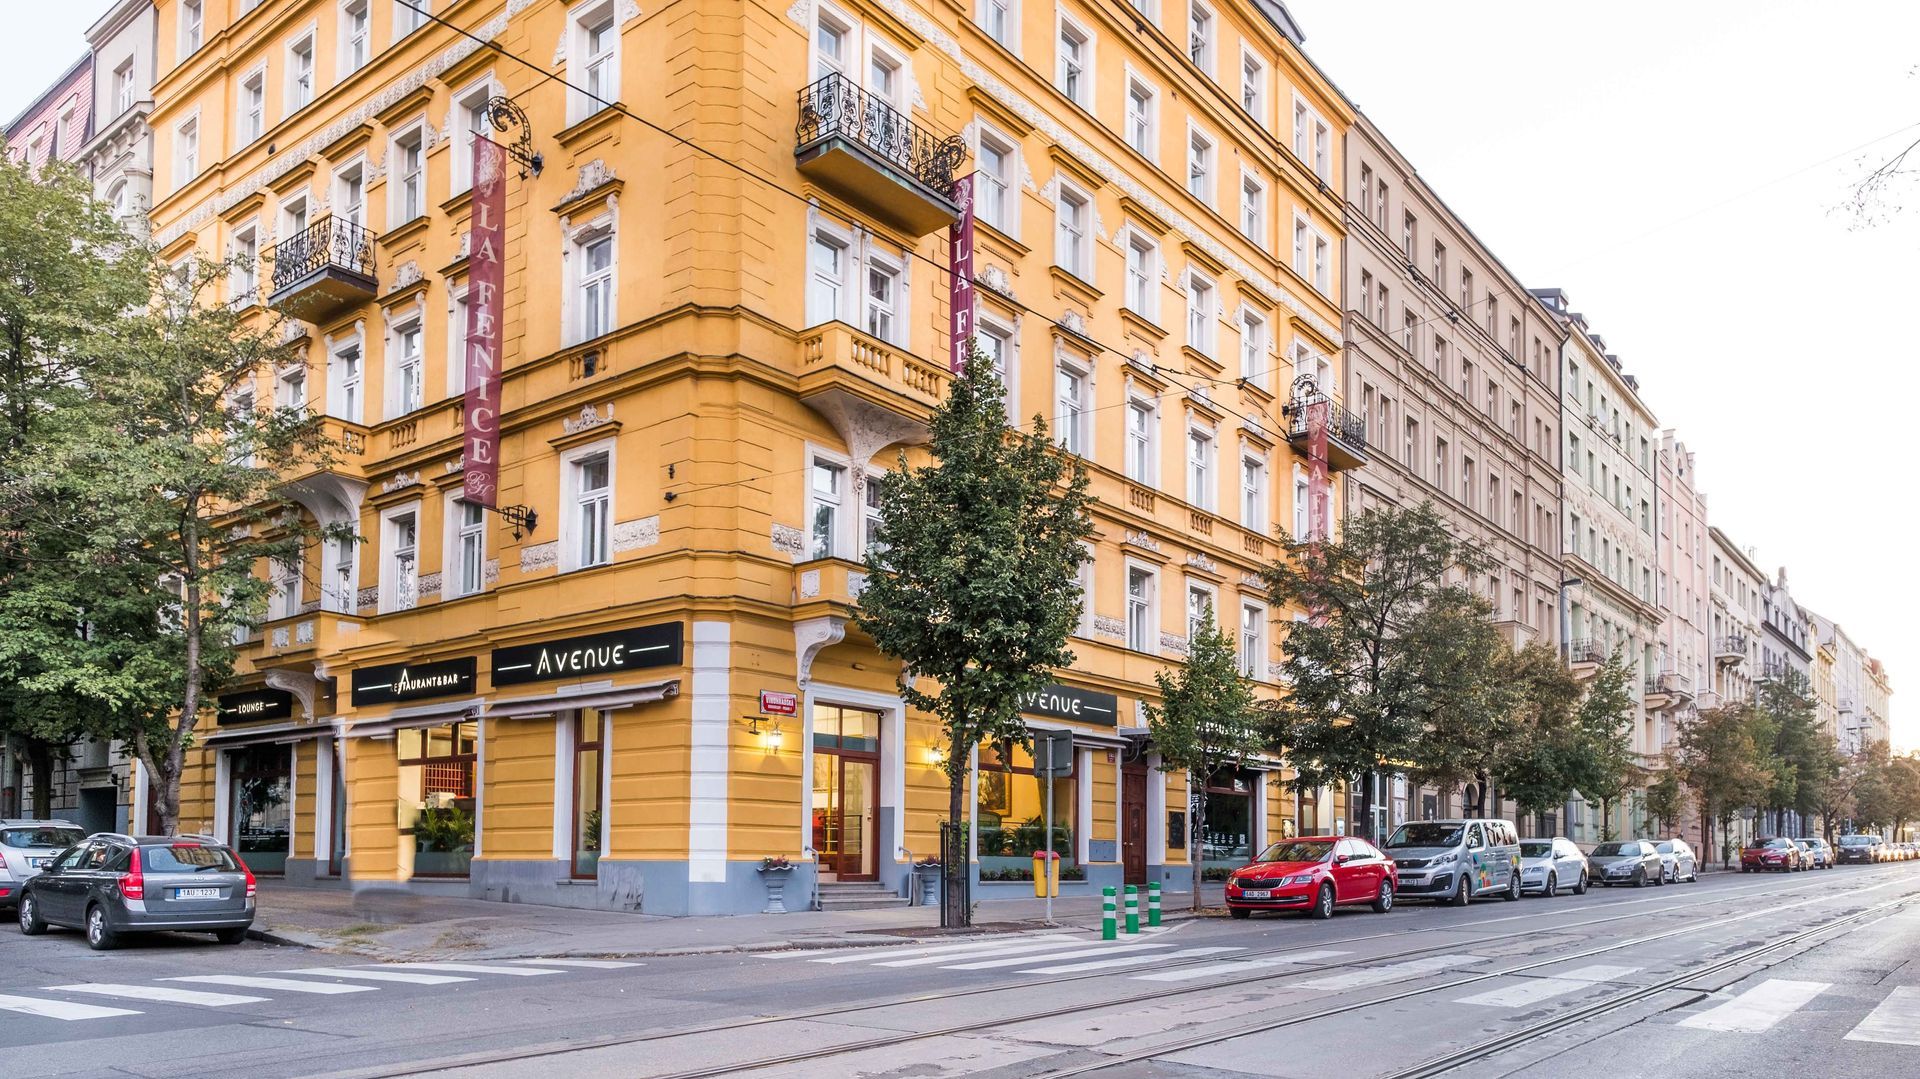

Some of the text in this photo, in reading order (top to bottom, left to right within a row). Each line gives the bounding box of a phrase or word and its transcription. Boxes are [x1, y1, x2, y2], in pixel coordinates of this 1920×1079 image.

[954, 239, 970, 379] LA FE
[470, 202, 499, 464] LA FENICE
[1311, 444, 1323, 481] LA
[536, 644, 624, 675] AVENUE
[238, 701, 264, 714] LOUNGE
